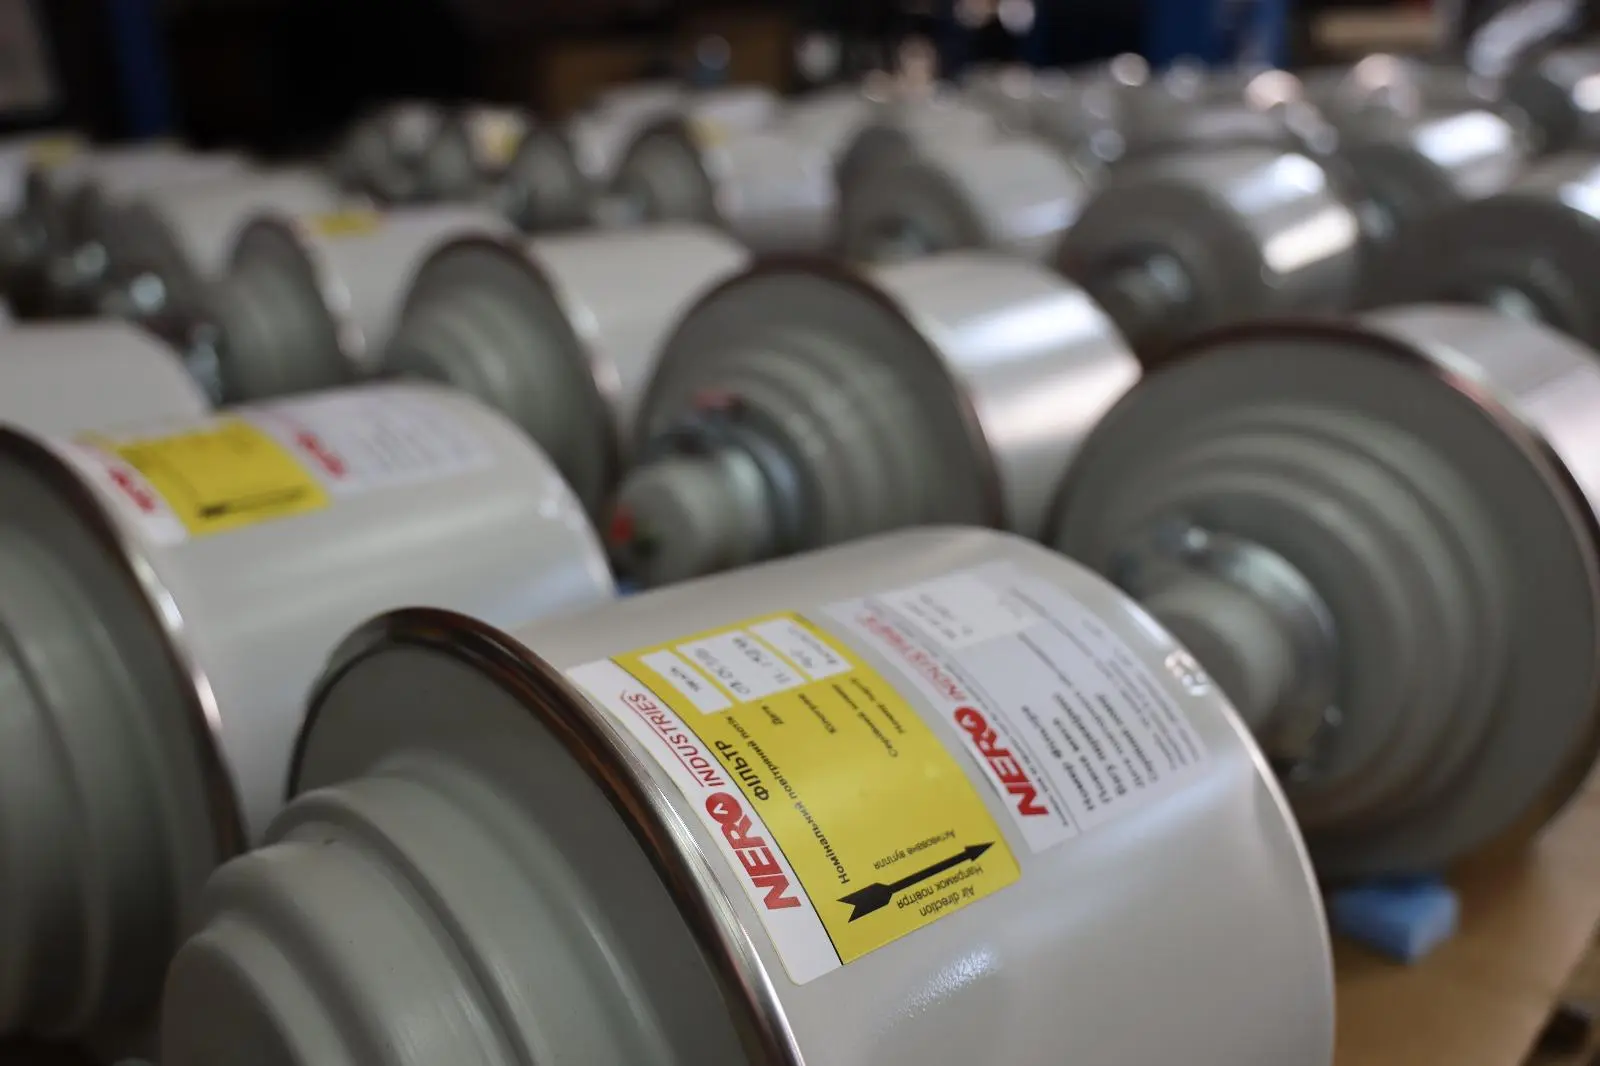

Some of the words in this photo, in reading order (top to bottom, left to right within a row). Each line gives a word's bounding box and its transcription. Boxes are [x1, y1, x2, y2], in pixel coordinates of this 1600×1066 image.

[629, 694, 724, 786] INDUSTRIES
[727, 716, 749, 739] потік
[715, 741, 769, 800] ФІЛЬТР
[748, 741, 796, 798] повітряний
[955, 708, 1048, 815] NERO
[706, 792, 801, 909] NERO
[795, 800, 851, 885] Номінальний
[906, 829, 955, 855] Активоване
[873, 848, 905, 870] вугілля
[934, 866, 983, 891] Напрямок
[897, 887, 934, 909] повітря
[919, 892, 960, 917] direction
[961, 886, 975, 899] Air
